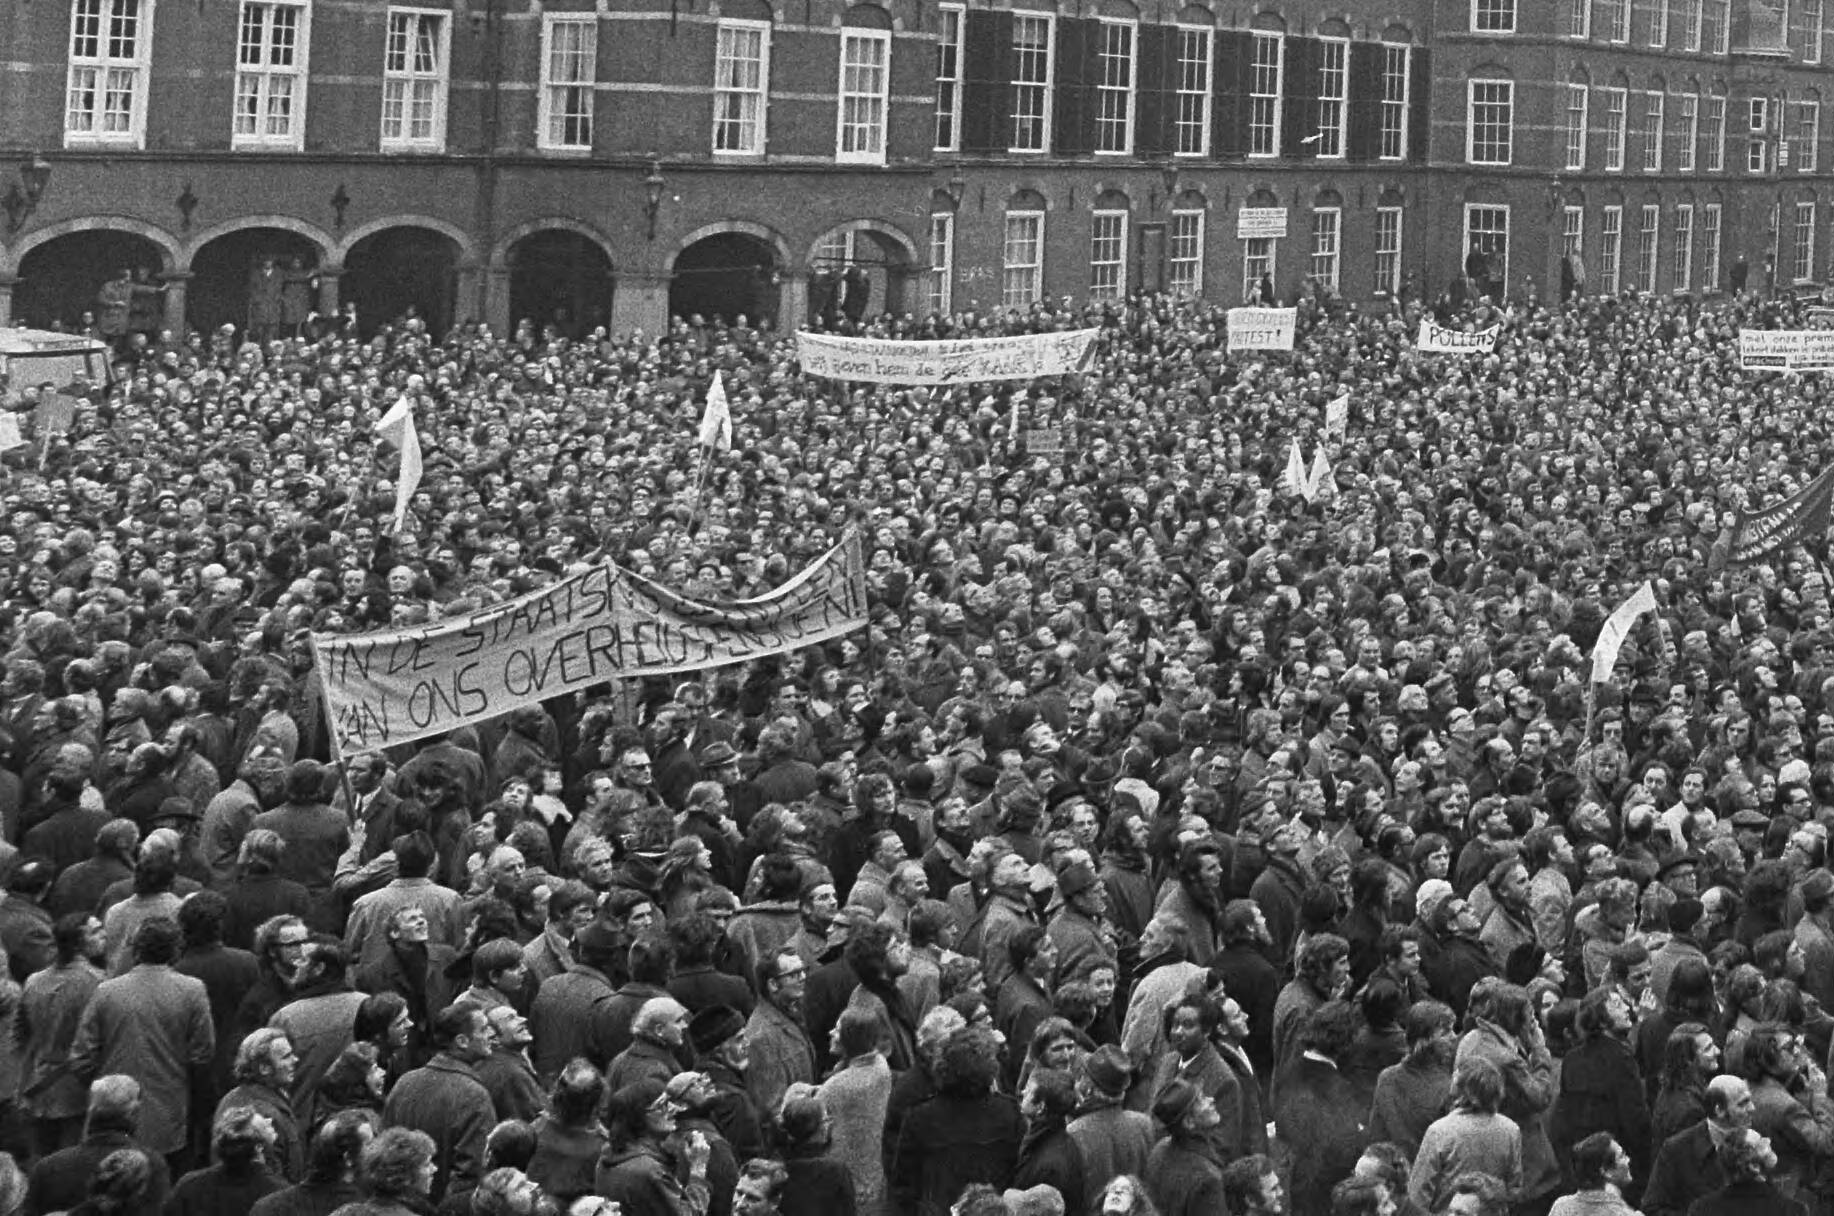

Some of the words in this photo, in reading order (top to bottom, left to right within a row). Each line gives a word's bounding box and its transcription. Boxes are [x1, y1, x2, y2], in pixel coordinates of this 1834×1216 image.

[1772, 334, 1797, 343] onze
[329, 640, 377, 685] IN
[387, 625, 446, 675] DE
[408, 660, 488, 728] ONS
